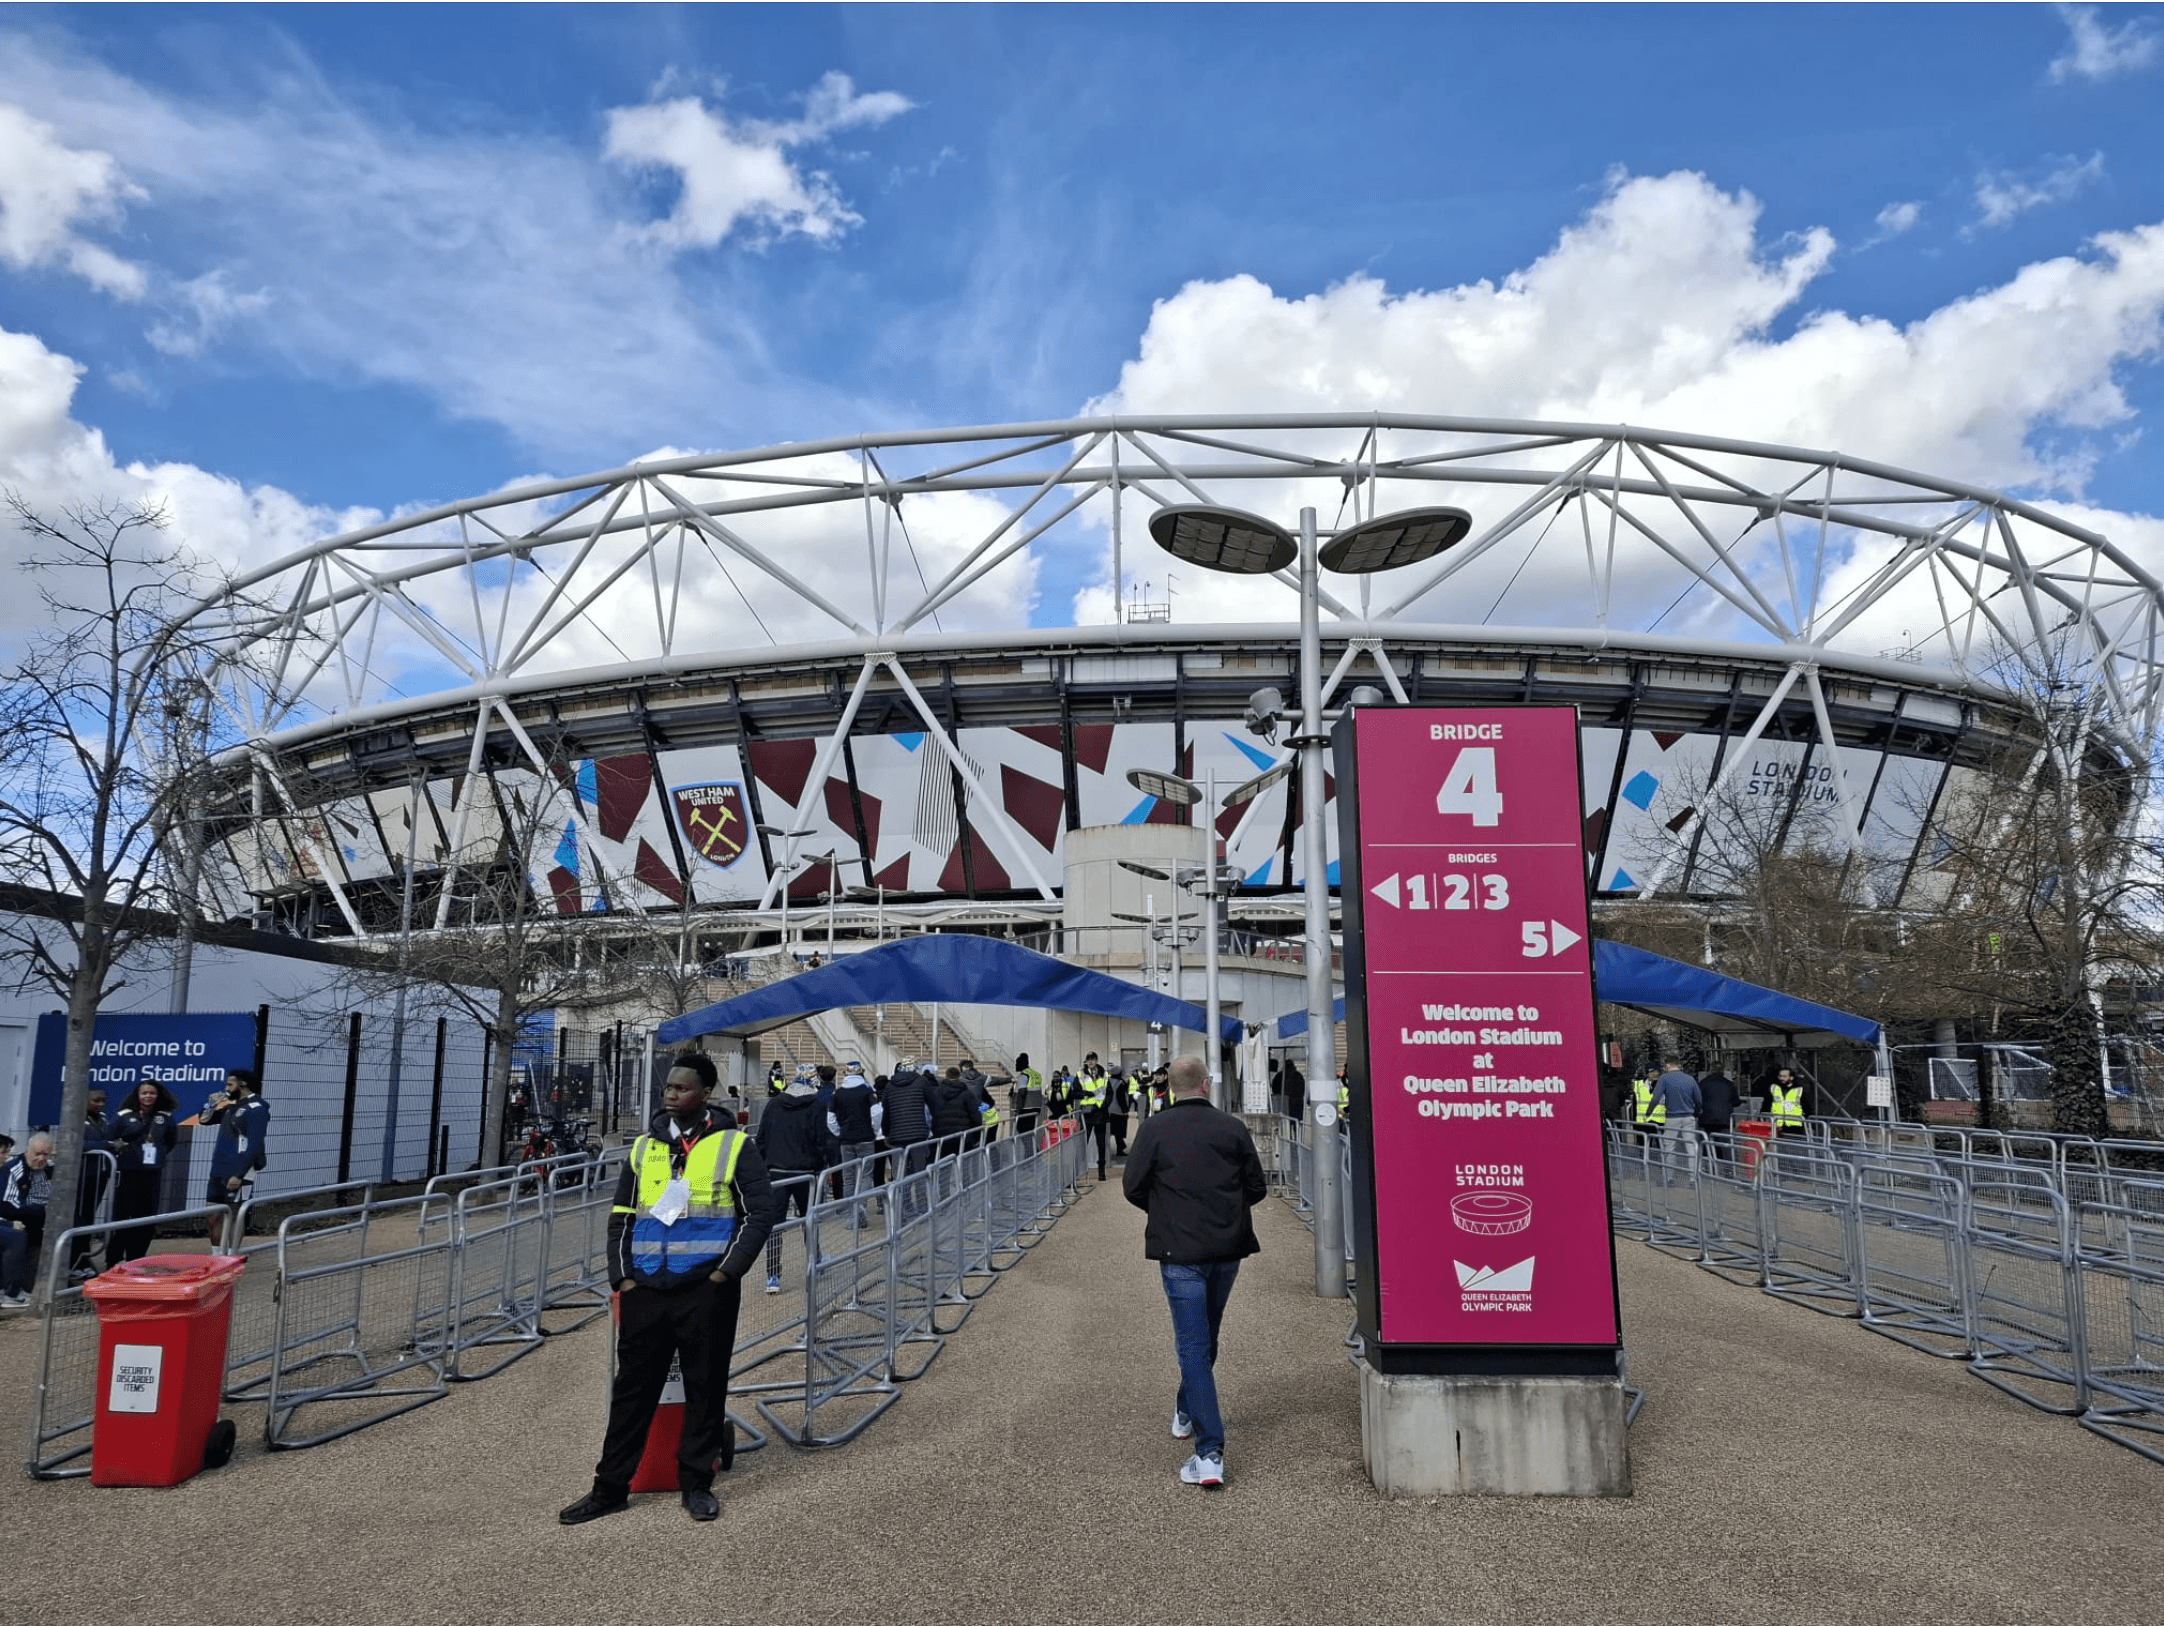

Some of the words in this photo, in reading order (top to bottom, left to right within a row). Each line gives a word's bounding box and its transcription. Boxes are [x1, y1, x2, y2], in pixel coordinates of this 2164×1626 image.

[1431, 724, 1502, 739] BRIDGE
[1752, 761, 1847, 782] LONDO
[678, 788, 706, 800] WEST
[707, 786, 735, 797] HAM
[1437, 747, 1503, 826] 4
[691, 797, 724, 806] UNITED
[1449, 854, 1497, 863] BRIDGES
[1522, 922, 1547, 957] 5
[1422, 1004, 1513, 1021] Welcome
[1517, 1005, 1538, 1020] to
[1401, 1028, 1475, 1044] London
[1480, 1028, 1562, 1044] Stadium
[90, 1039, 179, 1056] Welcome
[184, 1039, 206, 1056] to
[1473, 1052, 1494, 1068] at
[61, 1064, 136, 1081] ndon
[141, 1063, 225, 1081] Stadium
[1404, 1076, 1468, 1094] Queen
[1472, 1076, 1565, 1093] Elizabeth
[1418, 1100, 1502, 1120] Olympic
[1506, 1100, 1554, 1117] Park
[1455, 1164, 1524, 1175] LONDON
[1456, 1176, 1525, 1187] STADIUM
[1461, 1293, 1488, 1302] QUEEN
[1490, 1293, 1532, 1302] ELIZABETH
[1461, 1302, 1504, 1312] OLYMPIC
[1506, 1302, 1532, 1312] PARK
[119, 1366, 153, 1375] SECURITY
[116, 1375, 154, 1384] DISCARDED
[123, 1384, 145, 1392] ITEMS
